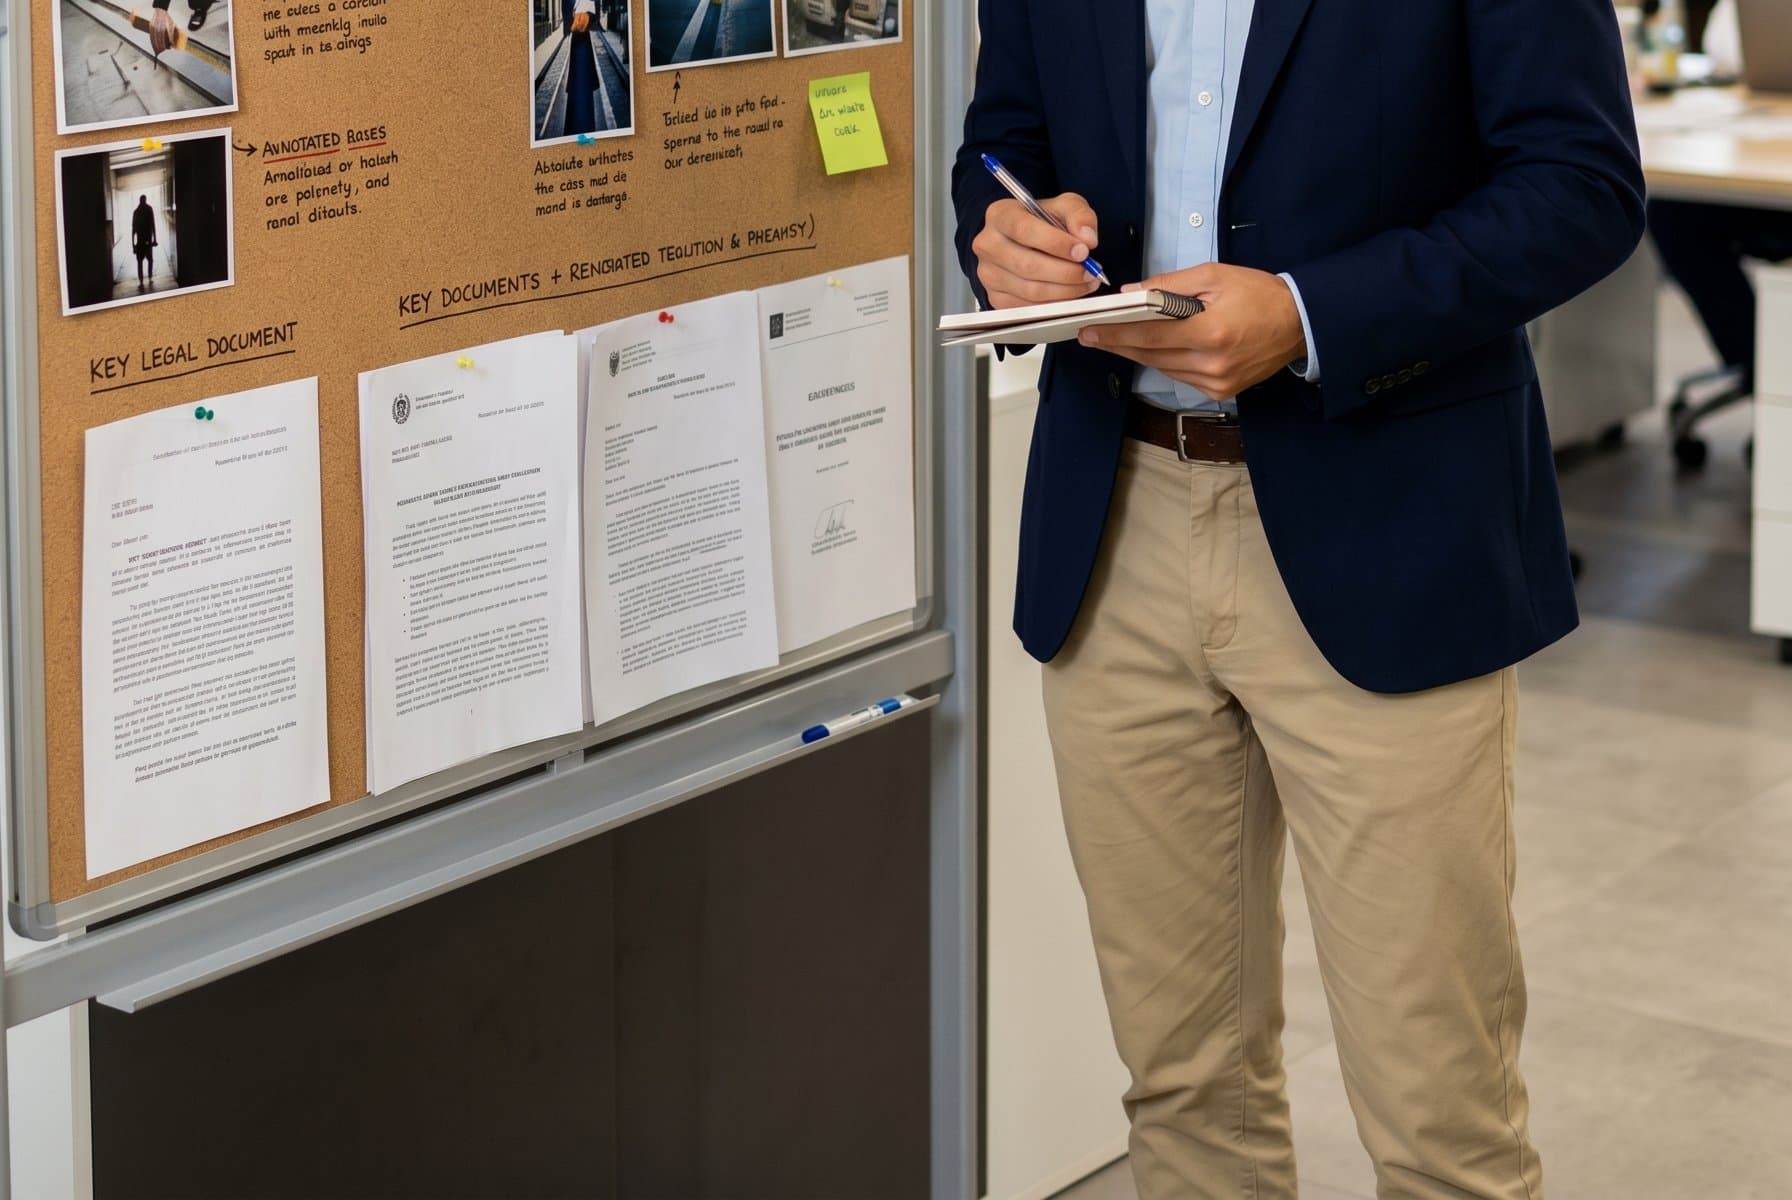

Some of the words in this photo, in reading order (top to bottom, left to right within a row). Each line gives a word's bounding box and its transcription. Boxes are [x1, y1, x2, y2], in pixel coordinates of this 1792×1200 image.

[724, 128, 741, 139] the
[366, 172, 389, 189] and
[535, 182, 554, 195] the
[572, 197, 581, 209] is
[400, 290, 431, 317] KEY
[442, 273, 540, 307] DOCUMENTS
[91, 353, 130, 383] KEY
[142, 342, 198, 372] LEGAL
[207, 321, 297, 358] DOCUMENT
